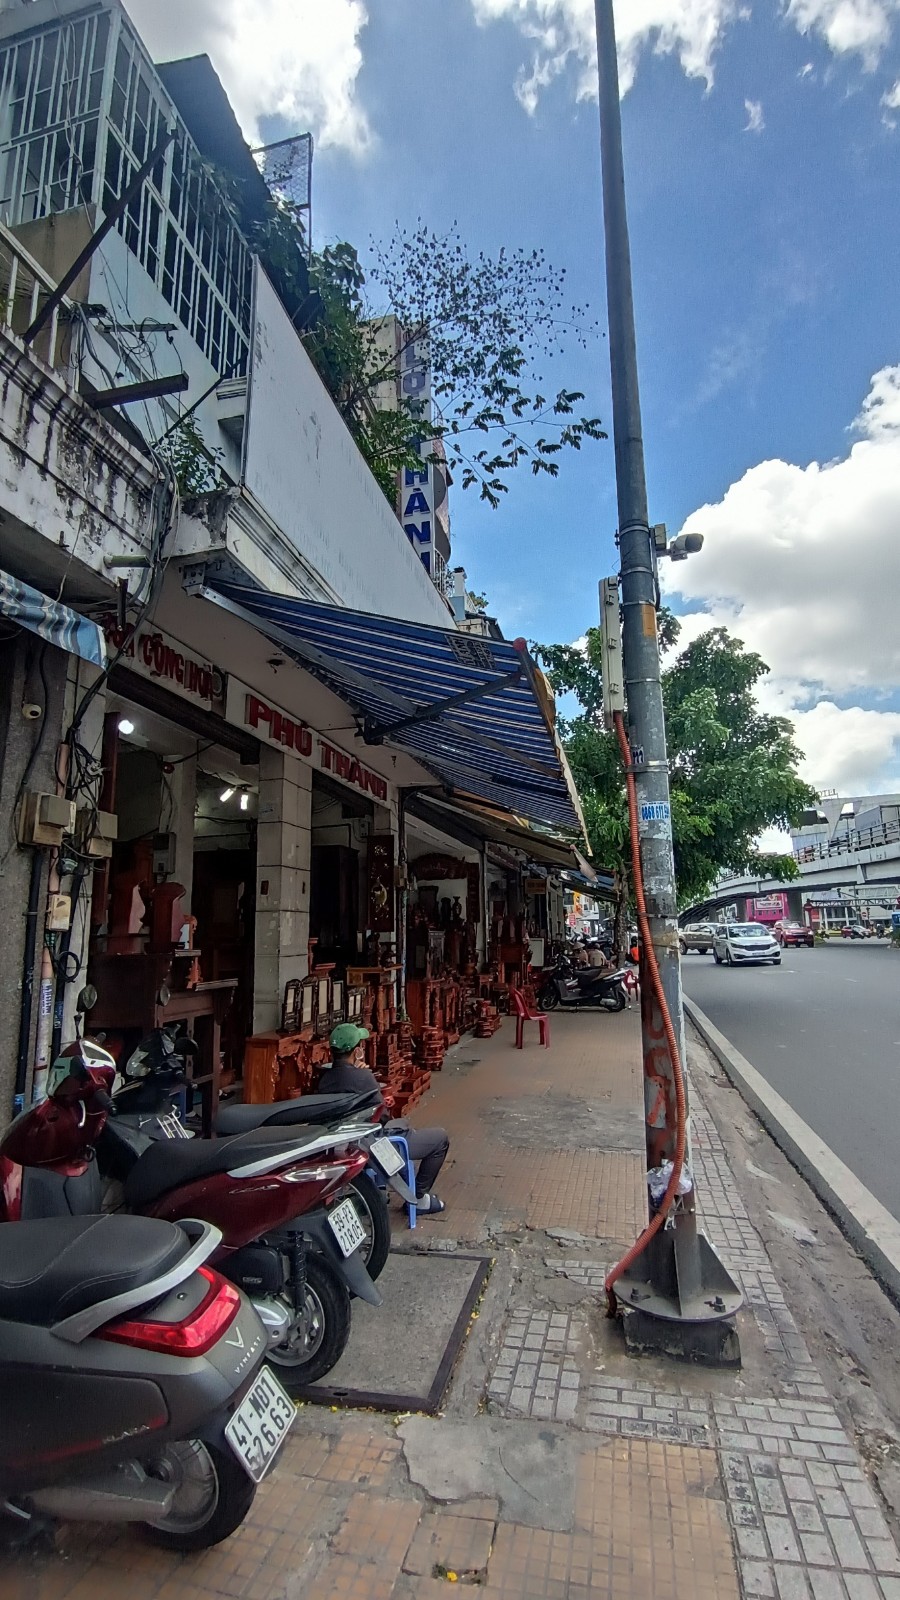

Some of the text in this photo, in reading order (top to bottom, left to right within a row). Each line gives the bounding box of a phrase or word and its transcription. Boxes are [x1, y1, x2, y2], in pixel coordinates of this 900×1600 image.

[246, 692, 388, 801] PHÚ THÀNH
[234, 1335, 261, 1374] VINFAST
